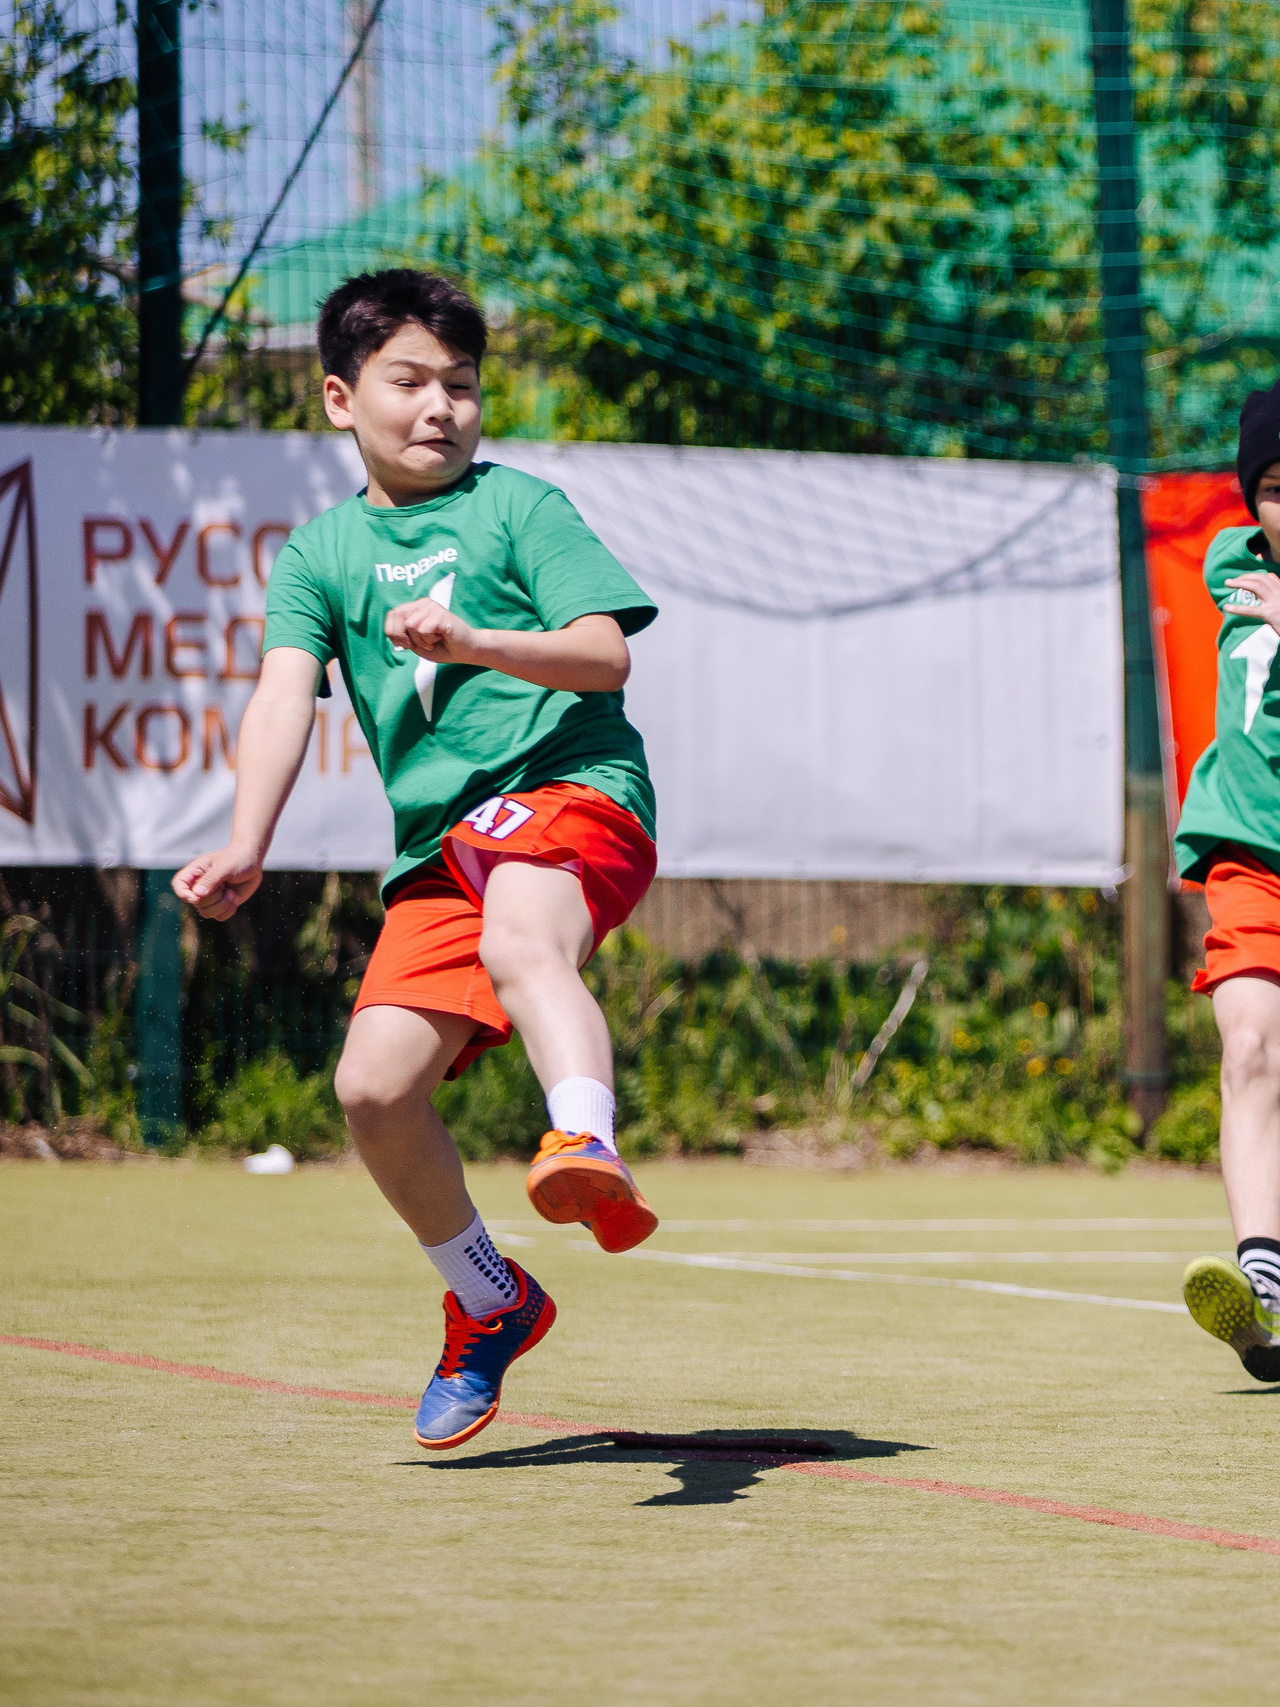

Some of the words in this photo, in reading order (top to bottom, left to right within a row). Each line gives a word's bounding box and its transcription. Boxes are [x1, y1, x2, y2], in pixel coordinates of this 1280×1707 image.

[82, 516, 293, 588] РУСС
[375, 547, 458, 586] Первые
[84, 610, 267, 681] МЕД
[83, 702, 371, 774] КОМА
[462, 796, 537, 840] 47
